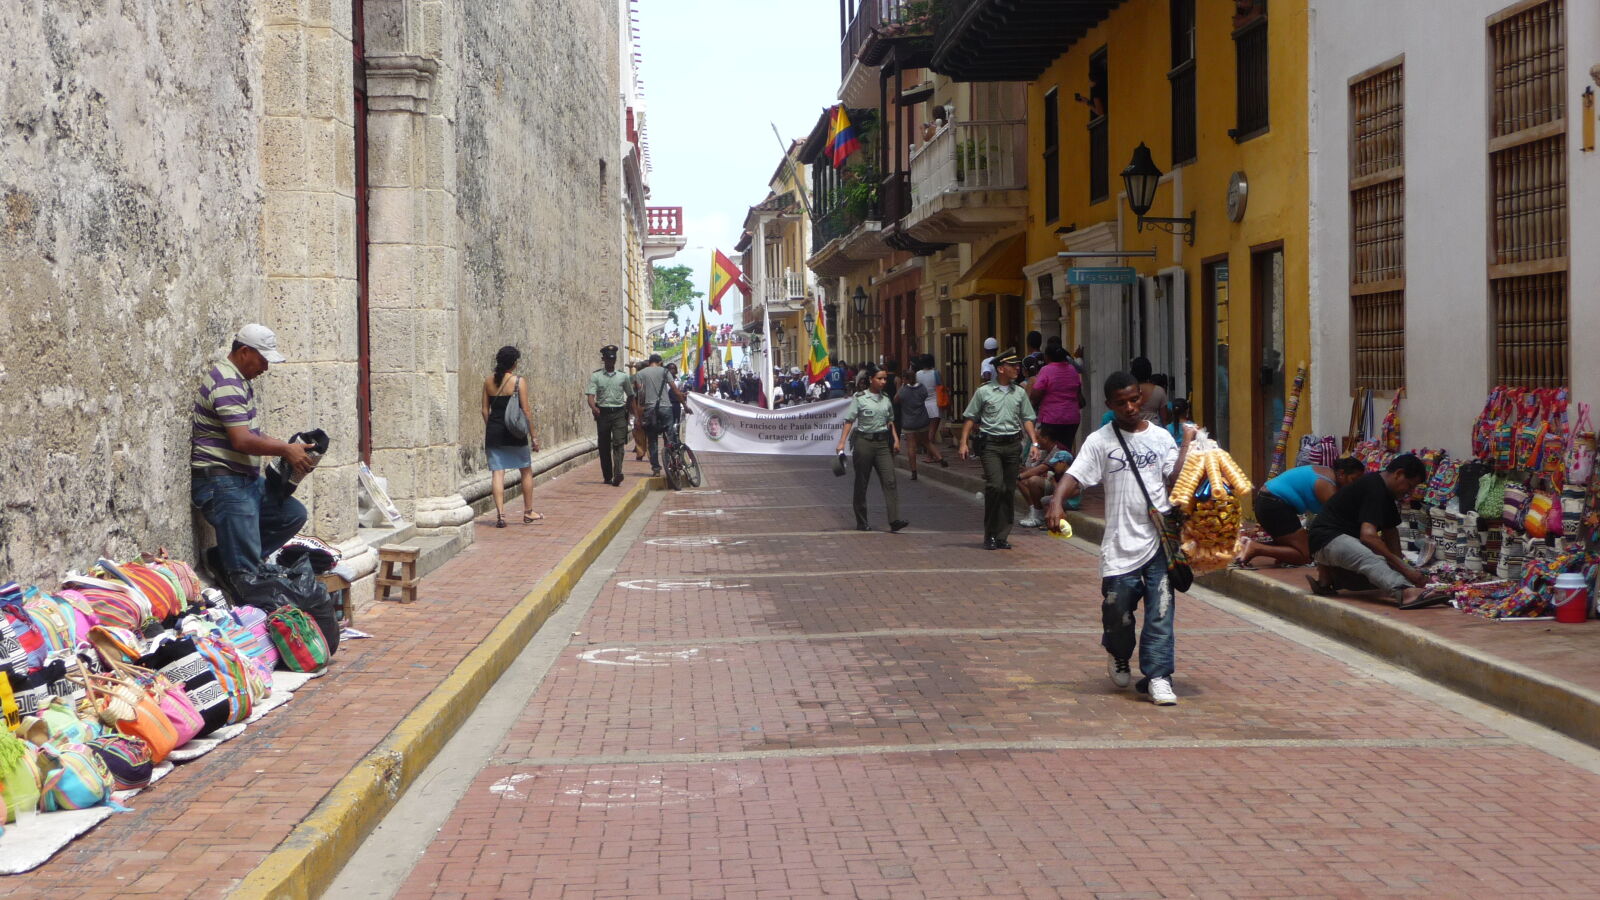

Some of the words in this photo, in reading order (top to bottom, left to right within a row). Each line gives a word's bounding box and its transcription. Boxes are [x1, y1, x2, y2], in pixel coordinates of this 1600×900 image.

[831, 371, 840, 382] 10
[798, 411, 837, 420] Educativa
[740, 421, 777, 430] Francisco
[778, 422, 788, 430] de
[790, 422, 812, 430] Paula
[813, 421, 845, 430] Santand
[758, 432, 798, 442] Cartagena
[799, 433, 809, 441] de
[811, 433, 834, 441] Indias
